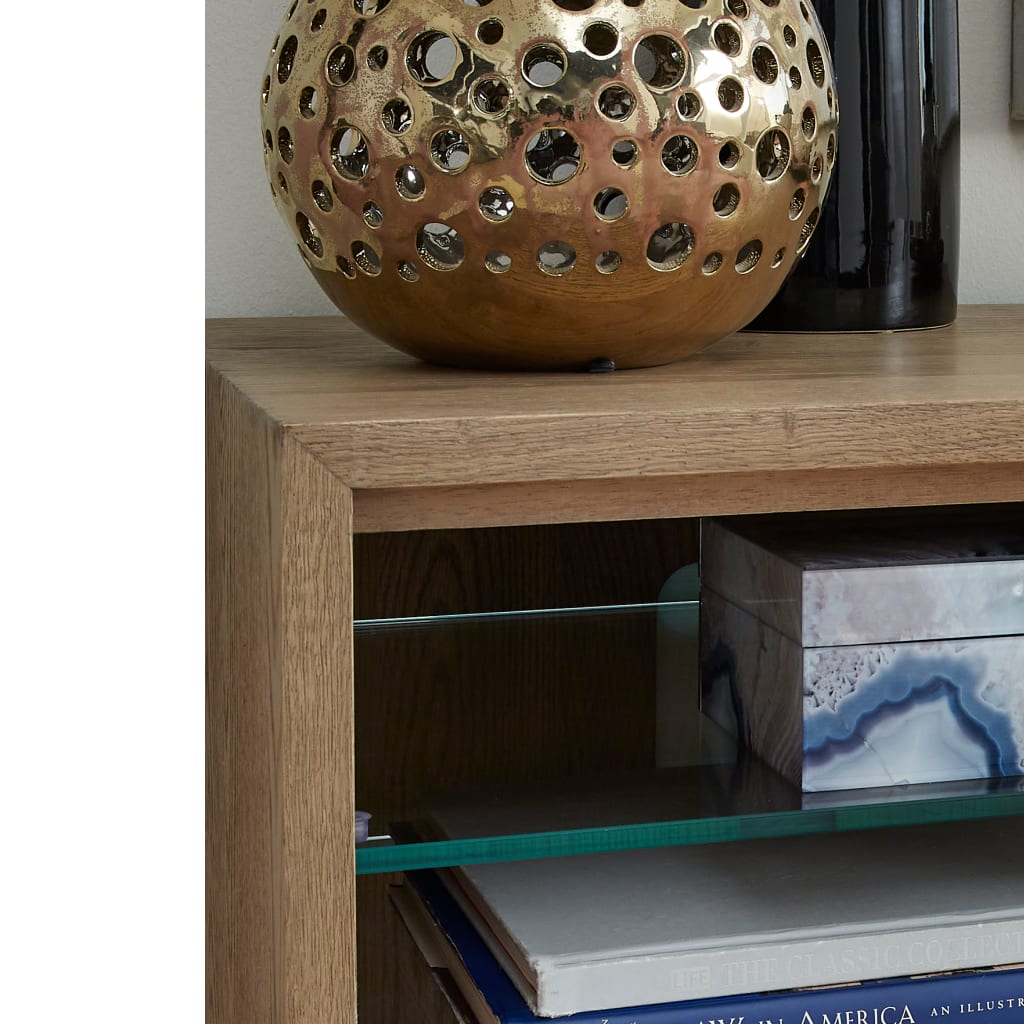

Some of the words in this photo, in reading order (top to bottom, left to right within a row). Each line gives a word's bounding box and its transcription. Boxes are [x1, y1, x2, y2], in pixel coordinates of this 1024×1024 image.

[722, 959, 777, 987] THE
[787, 945, 901, 981] CLASSIC
[930, 1005, 951, 1017] AN
